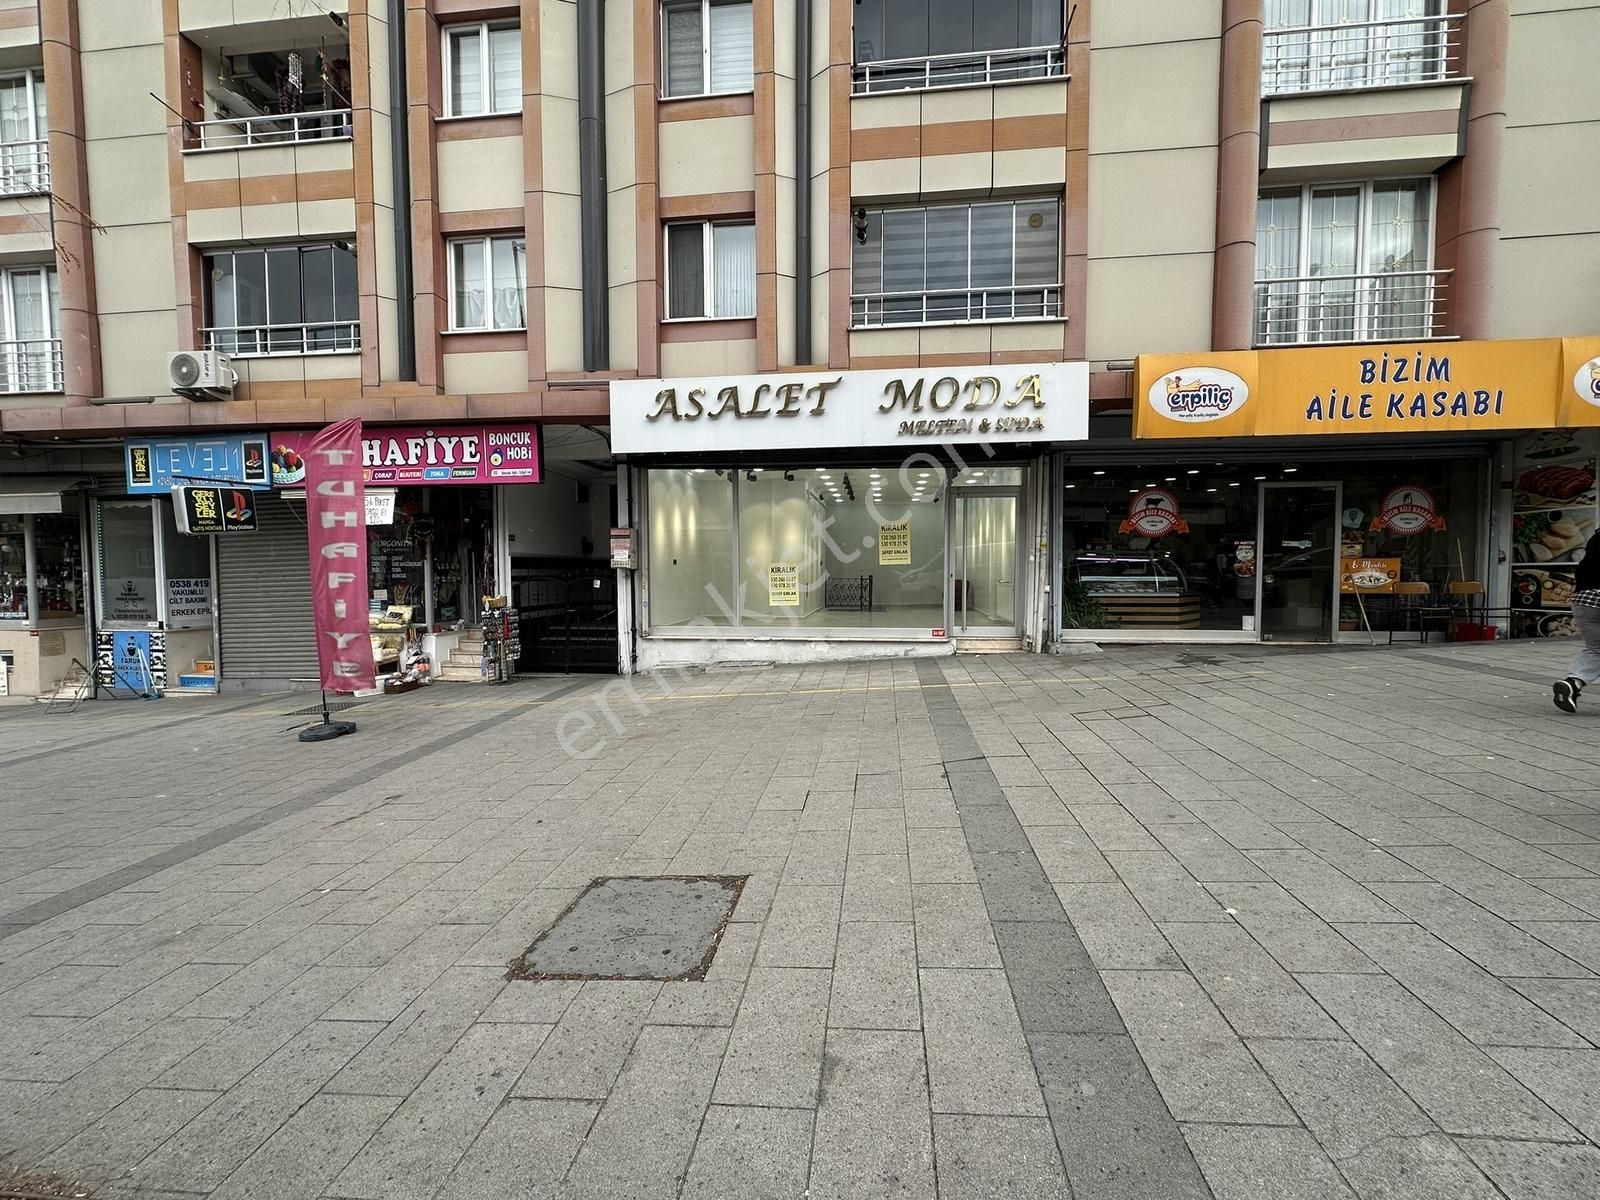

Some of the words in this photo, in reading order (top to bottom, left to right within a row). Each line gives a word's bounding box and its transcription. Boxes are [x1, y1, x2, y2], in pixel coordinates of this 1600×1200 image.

[1360, 352, 1450, 384] BİZİM
[646, 376, 844, 421] ASALET
[879, 374, 1046, 413] MODA
[1168, 385, 1231, 410] erpiliç
[1306, 389, 1373, 420] AİLE
[1387, 389, 1504, 419] KASABI
[979, 417, 991, 433] &
[489, 432, 531, 446] BONCUK
[881, 523, 908, 531] KİRALIK
[316, 448, 366, 677] TUHAFİYE
[770, 565, 796, 574] KİRALIK
[170, 580, 191, 588] 0538
[193, 579, 209, 588] 419
[185, 596, 208, 604] BAKIMI
[171, 608, 196, 616] ERKEK
